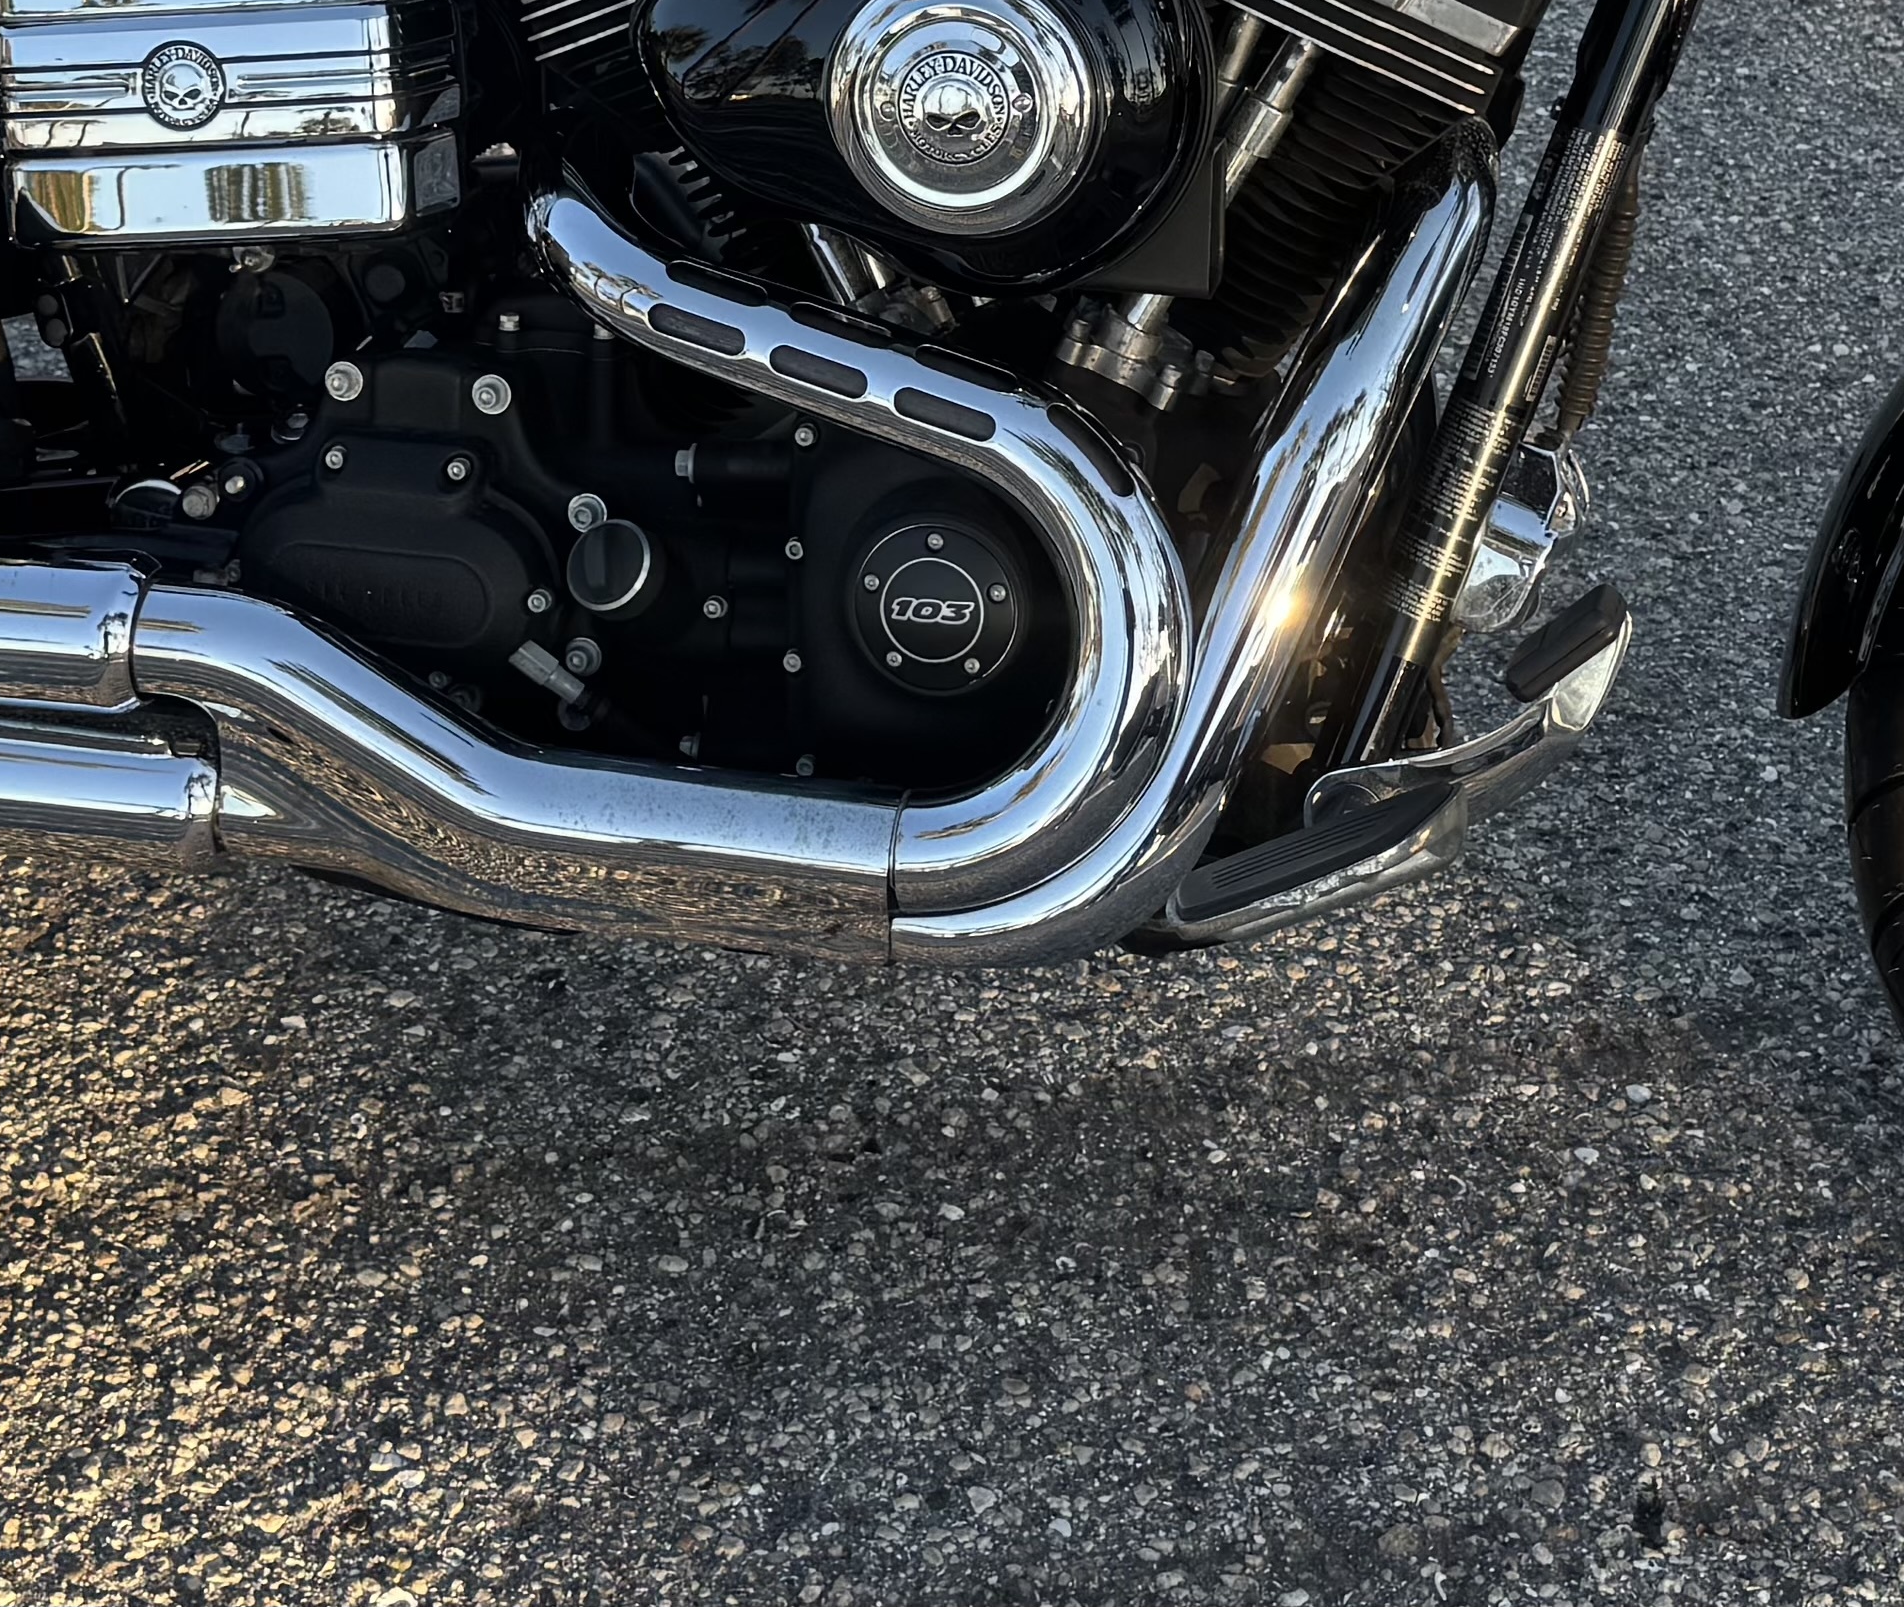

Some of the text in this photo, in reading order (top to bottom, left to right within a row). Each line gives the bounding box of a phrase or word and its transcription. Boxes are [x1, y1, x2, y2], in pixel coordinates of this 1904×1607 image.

[144, 46, 220, 95] HARLEY-DAVIDSON
[902, 55, 1007, 120] HARLEY-DAVIDSON
[891, 597, 975, 625] 103
